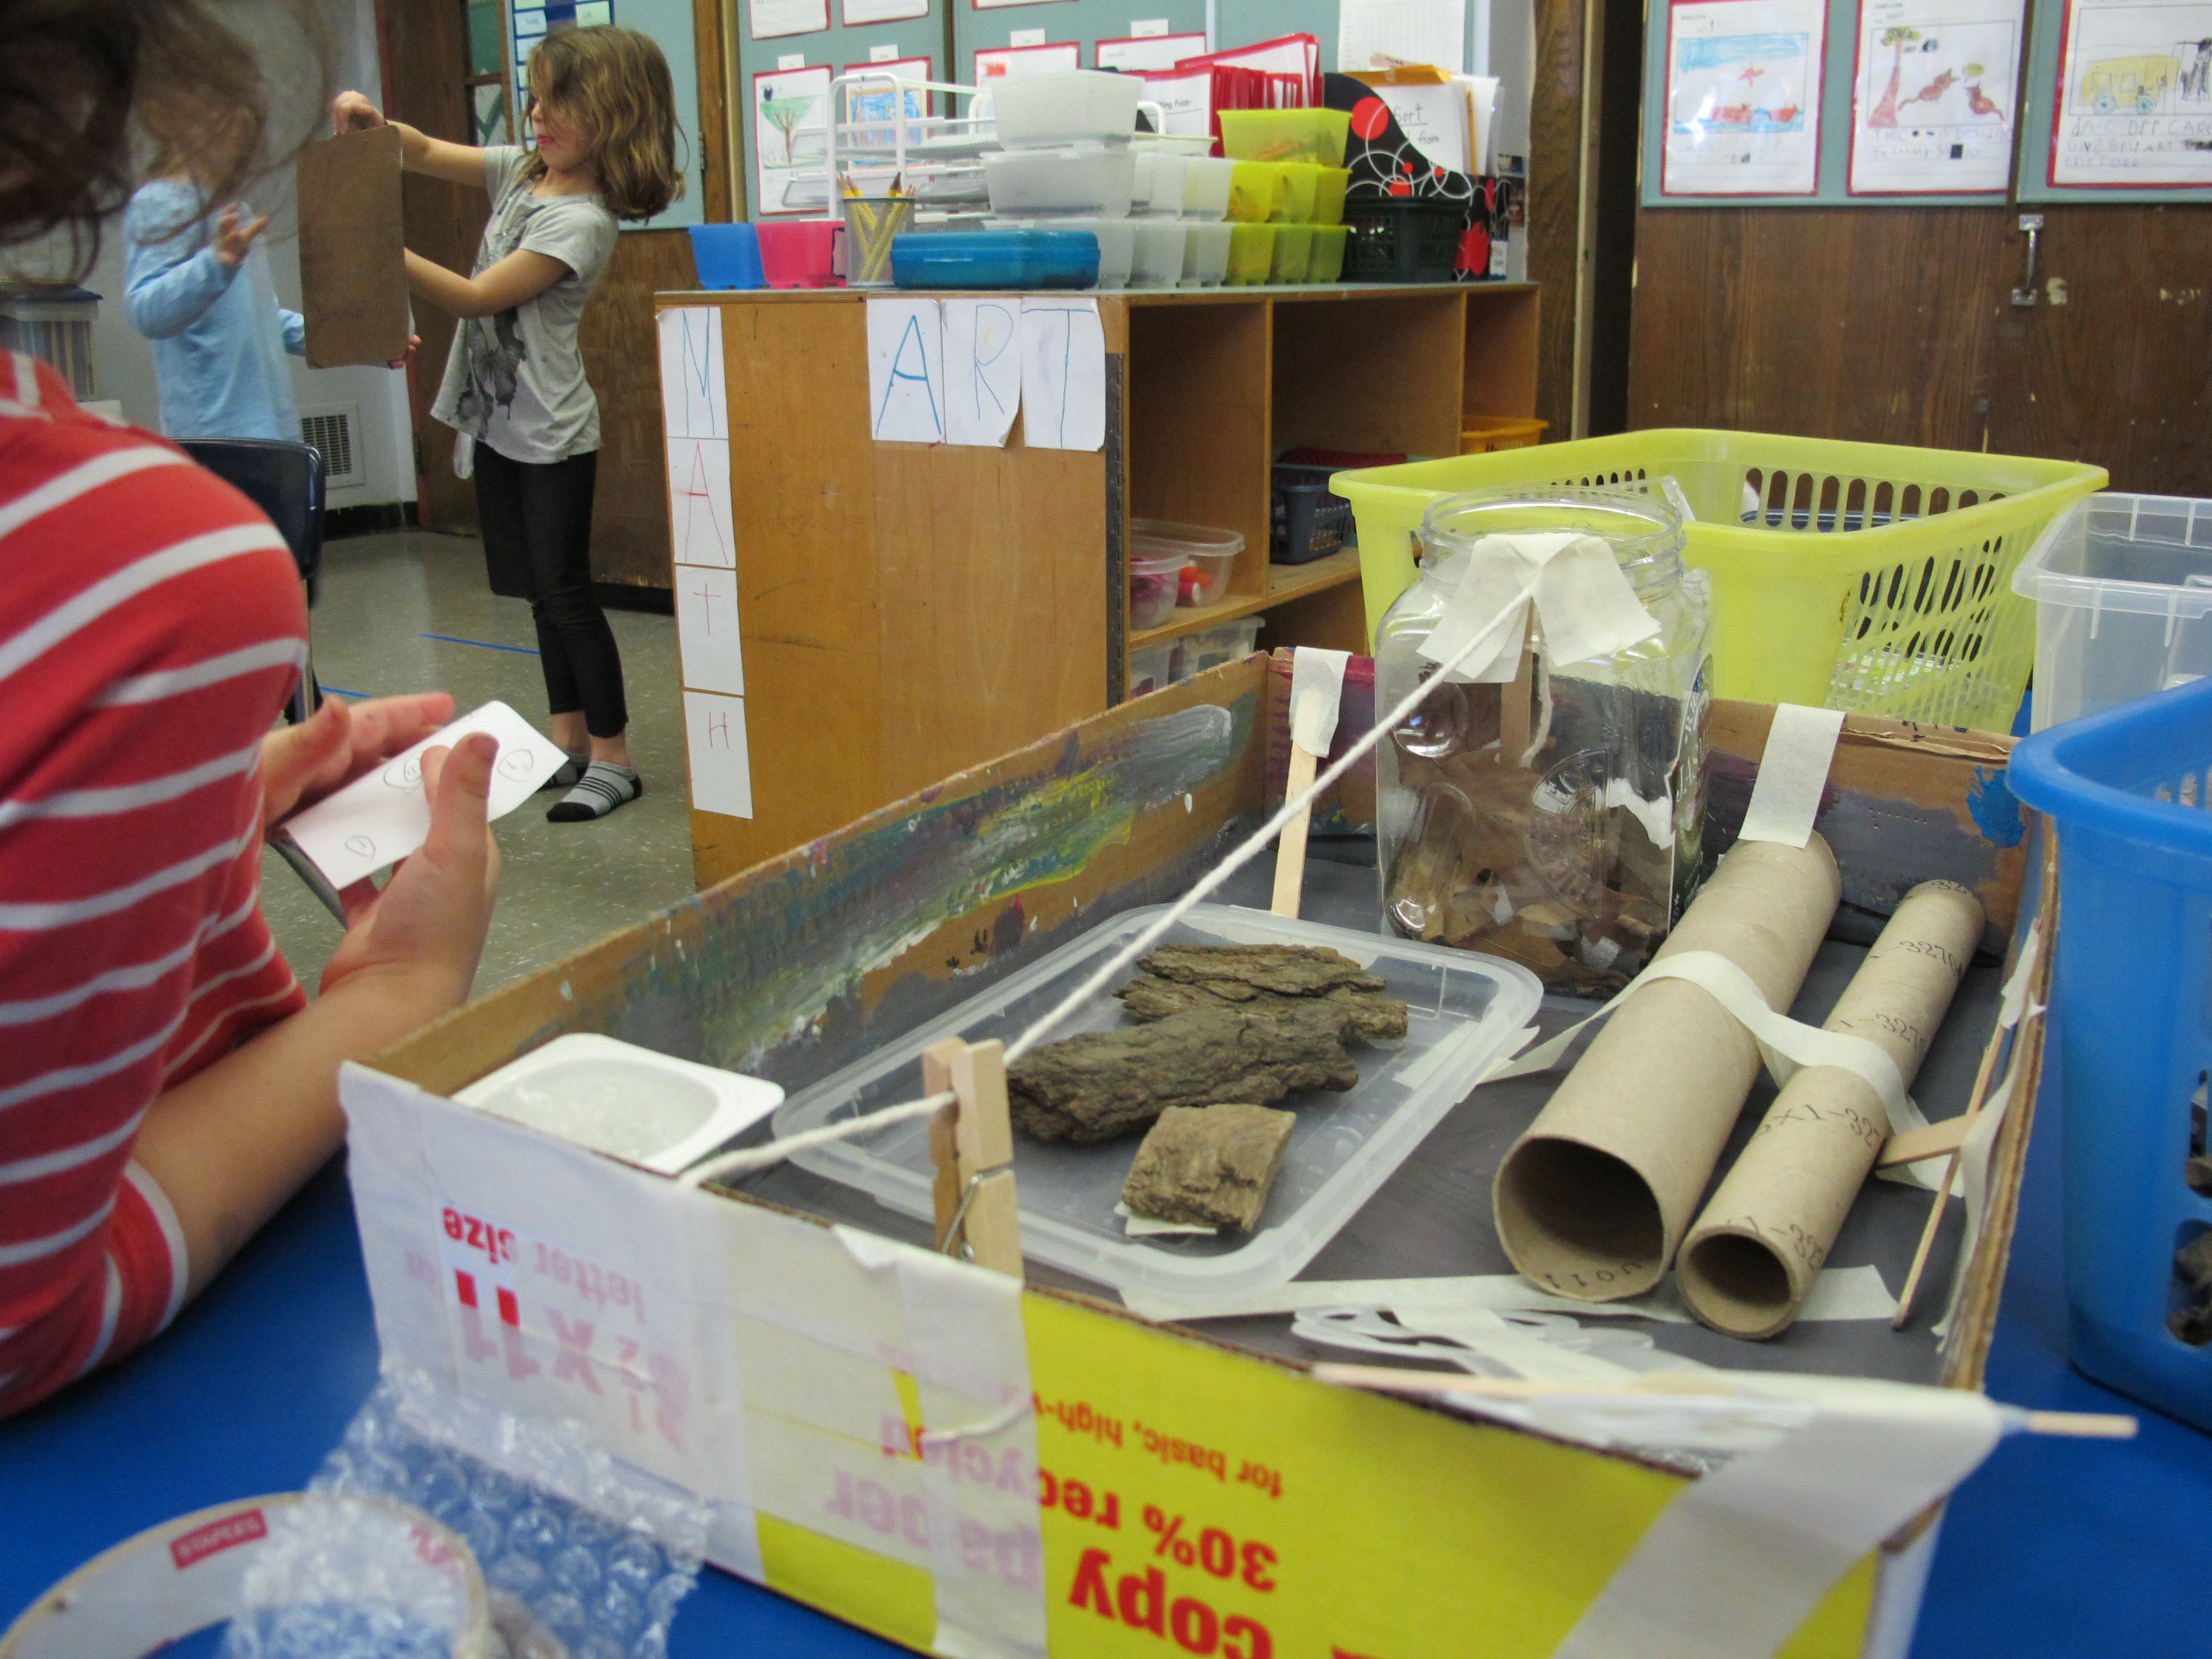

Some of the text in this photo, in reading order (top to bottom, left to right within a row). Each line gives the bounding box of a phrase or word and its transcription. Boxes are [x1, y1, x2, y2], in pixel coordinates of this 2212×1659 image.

[875, 304, 1096, 449] ART
[443, 1206, 517, 1265] size
[1132, 1419, 1228, 1483] basic,
[1237, 1458, 1284, 1499] for
[1142, 1504, 1278, 1593] 30%
[1068, 1547, 1274, 1659] copy
